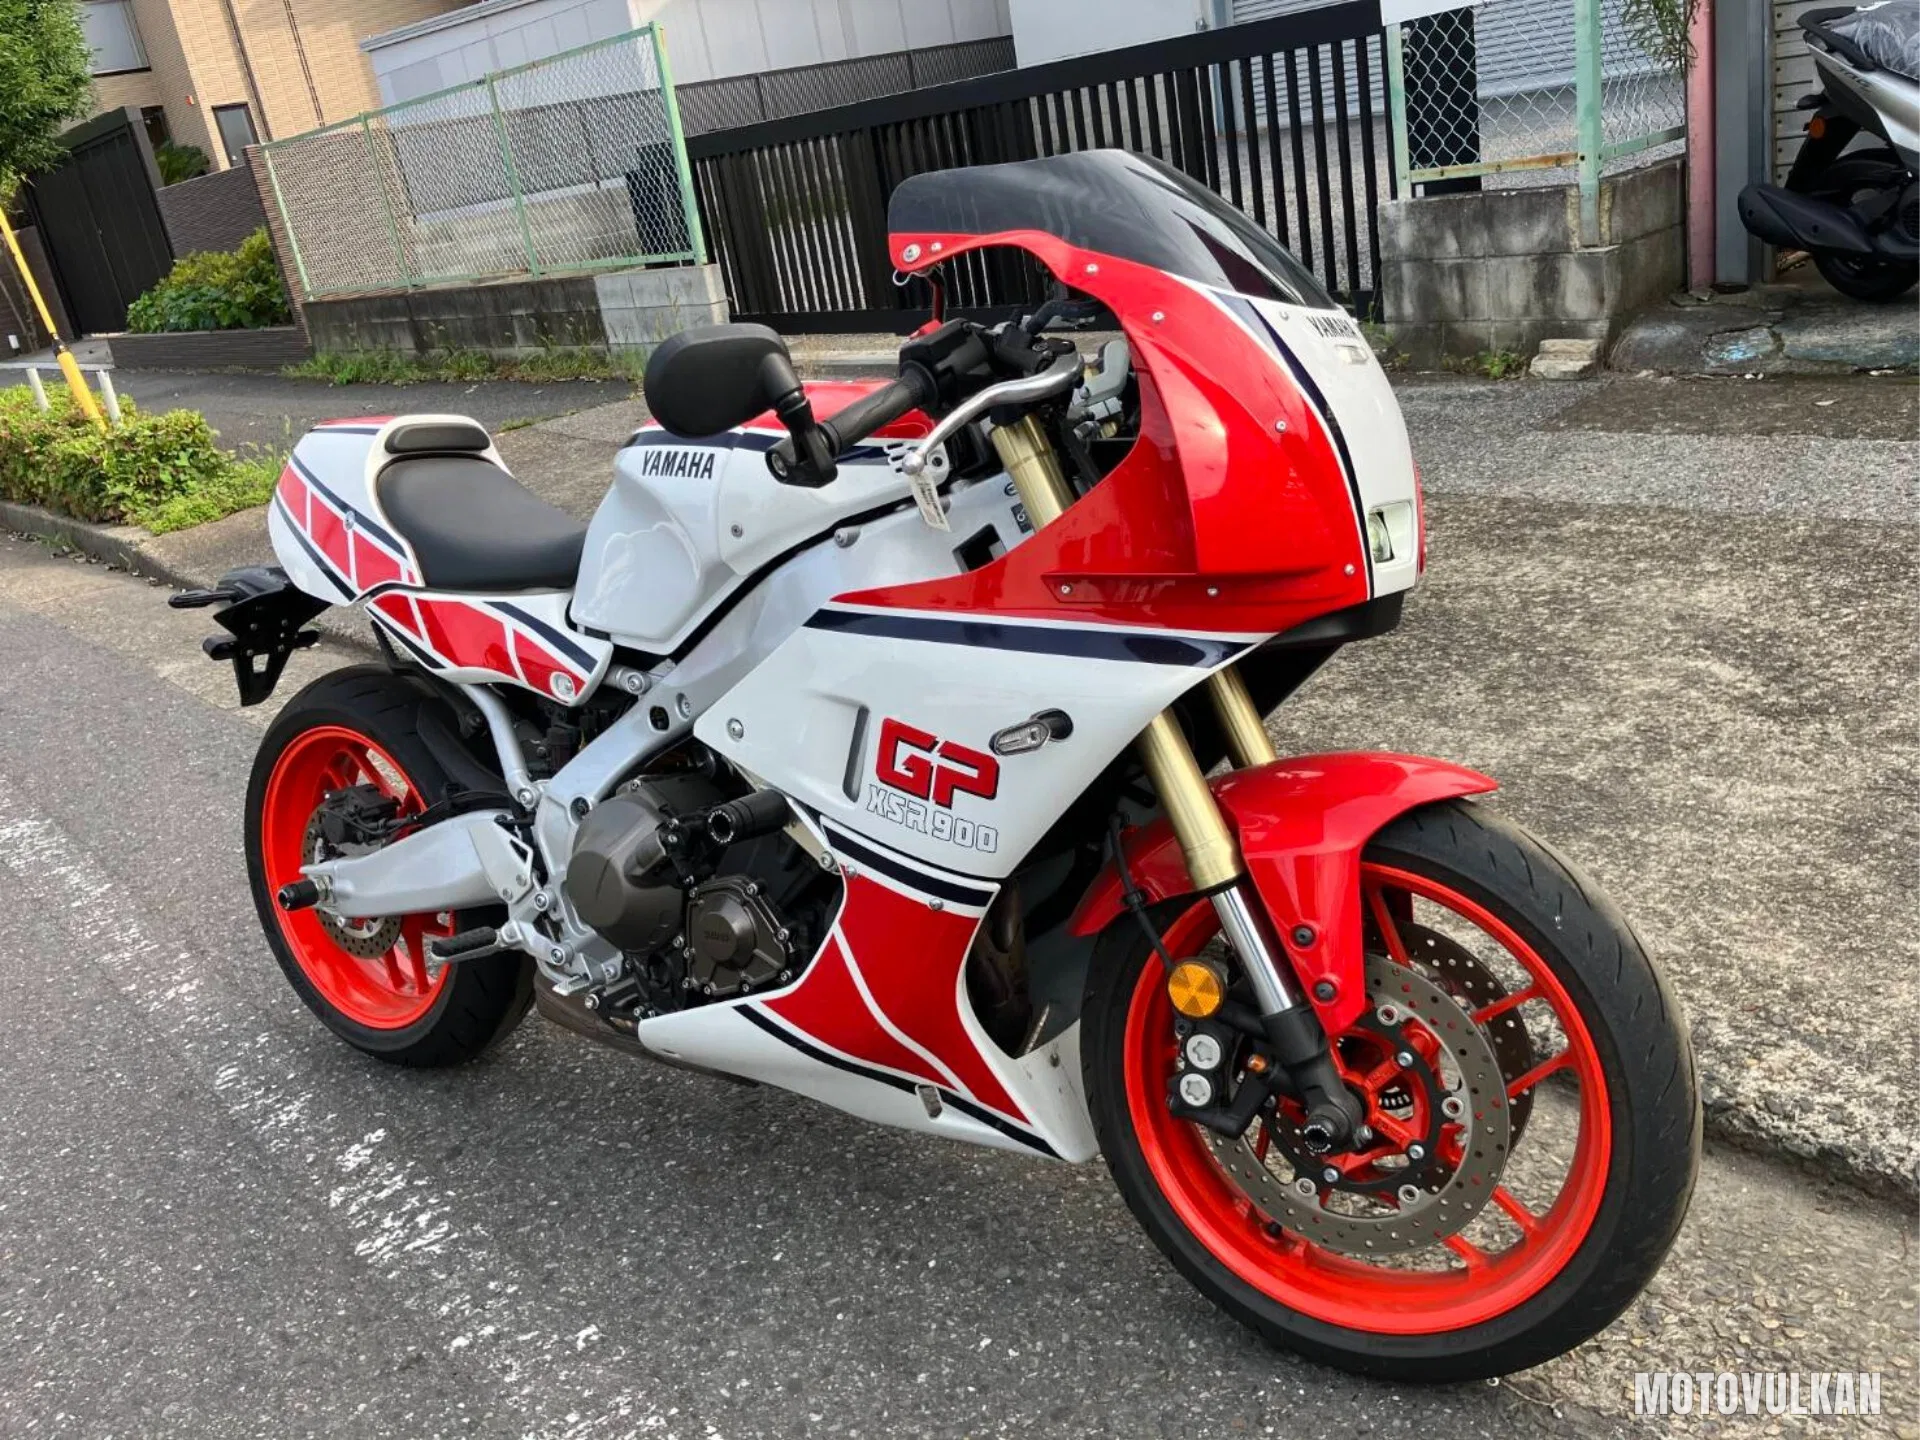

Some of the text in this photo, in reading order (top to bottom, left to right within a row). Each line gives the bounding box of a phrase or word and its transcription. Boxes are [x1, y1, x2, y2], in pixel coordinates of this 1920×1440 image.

[1305, 316, 1359, 339] YAMAHA
[642, 450, 715, 479] YAMAHA
[876, 717, 1000, 810] GP
